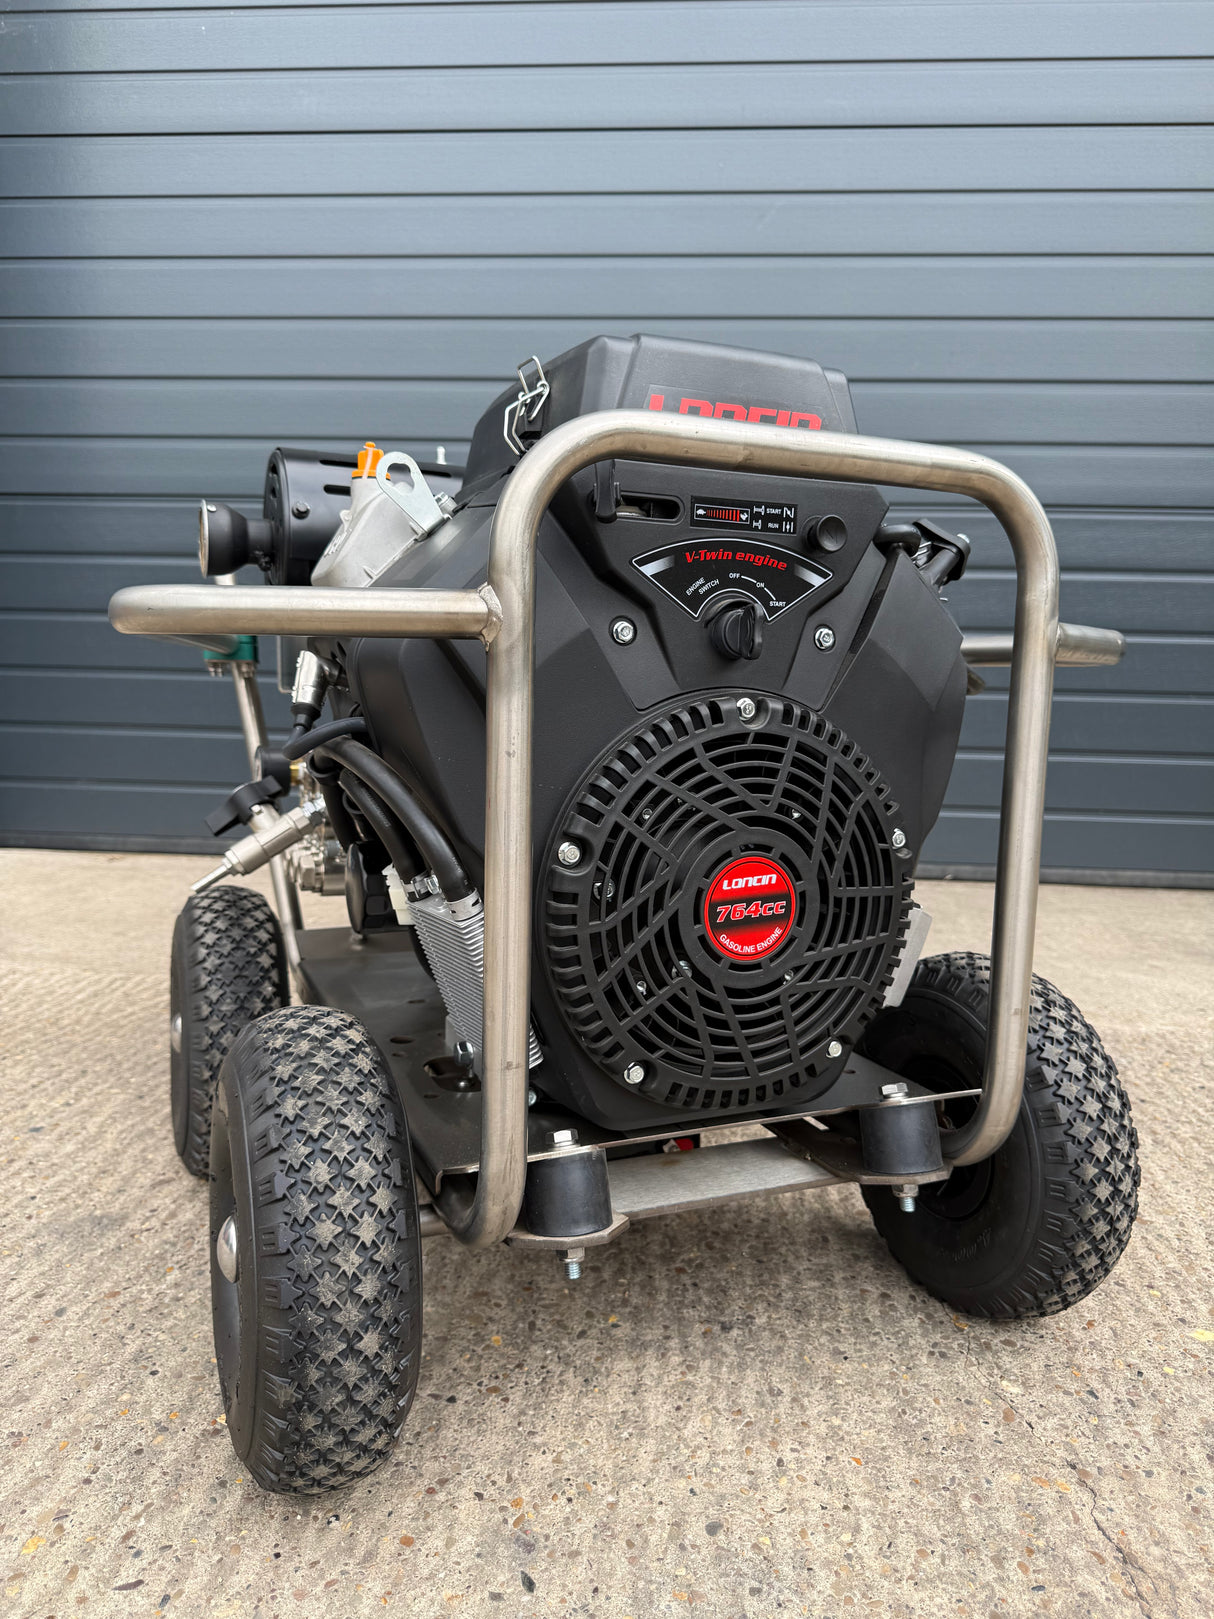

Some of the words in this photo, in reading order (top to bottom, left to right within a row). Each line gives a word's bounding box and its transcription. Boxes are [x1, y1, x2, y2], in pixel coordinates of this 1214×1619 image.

[766, 507, 782, 515] START
[685, 548, 733, 563] V-Twin
[735, 551, 788, 571] engine
[685, 577, 706, 596] ENGINE
[698, 579, 720, 595] SWITCH
[716, 901, 787, 923] 764cc
[719, 934, 756, 953] GASOLINE
[756, 926, 783, 951] ENGINE
